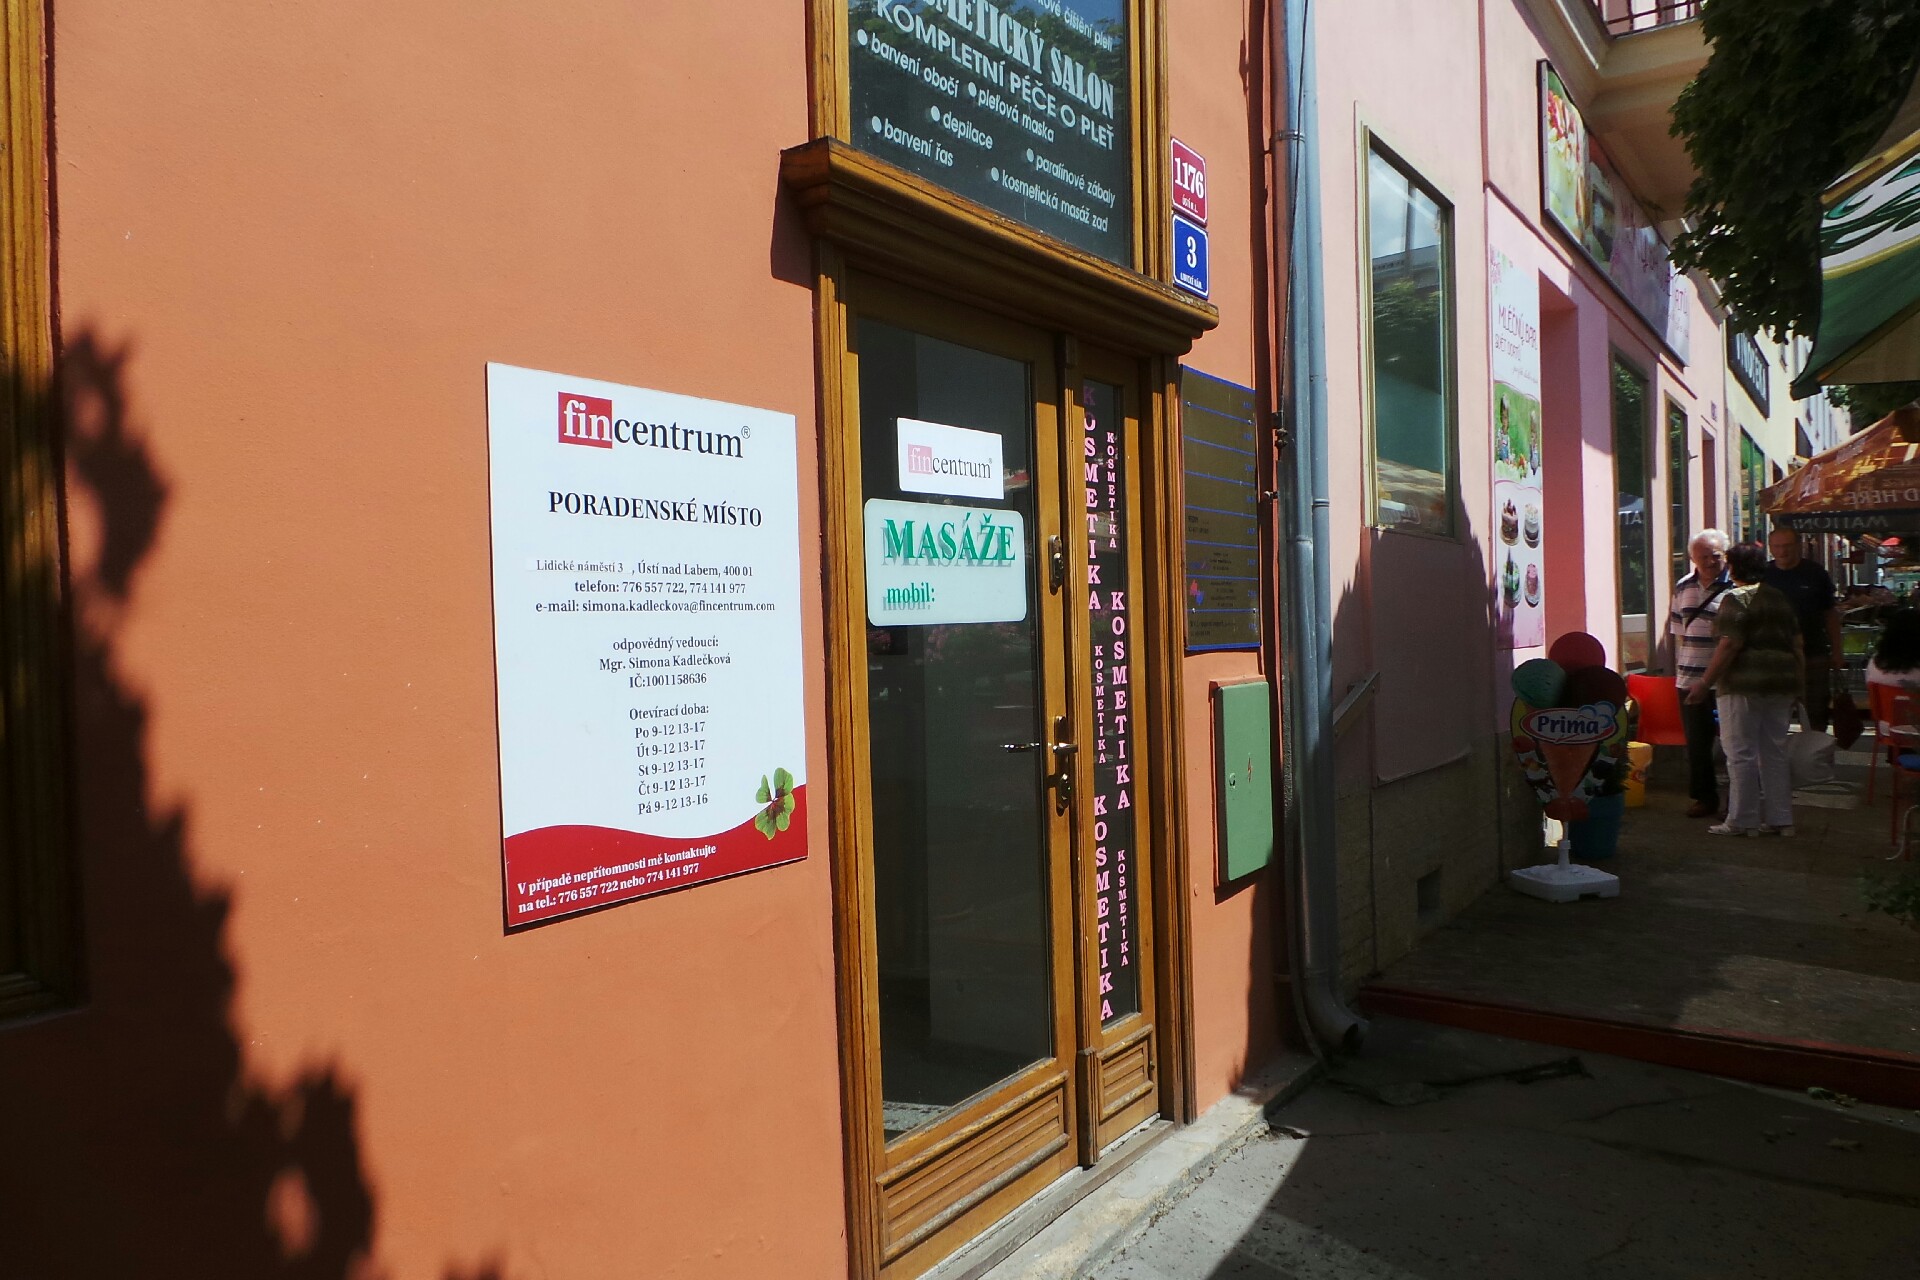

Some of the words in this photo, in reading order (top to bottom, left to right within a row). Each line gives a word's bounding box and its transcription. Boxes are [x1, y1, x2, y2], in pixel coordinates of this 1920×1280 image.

[871, 33, 921, 76] barvení
[923, 65, 960, 98] obočí
[877, 0, 1006, 87] KOMPLETNÍ
[1010, 74, 1056, 118] PÉČE
[1060, 104, 1076, 128] O
[1081, 114, 1114, 151] PLEŤ
[1050, 46, 1114, 119] SALON
[943, 111, 993, 150] depilace
[978, 86, 1019, 121] pleťová
[1022, 111, 1055, 143] maska
[884, 119, 932, 158] barvení
[935, 142, 954, 167] řas
[1087, 179, 1116, 209] zábaly
[1174, 157, 1205, 199] 1176
[1001, 170, 1058, 210] kosmetická
[1061, 198, 1090, 225] masáž
[1092, 213, 1108, 233] zad
[1186, 236, 1197, 268] 3
[548, 490, 698, 523] PORADENSKÉ
[702, 500, 762, 527] MÍSTO
[1083, 386, 1101, 611] KOSMETIKA
[1106, 431, 1117, 549] KOSMETIKA
[883, 512, 1016, 563] MASÁŽE
[536, 559, 575, 572] Lidické
[577, 560, 616, 573] náměstí
[617, 563, 624, 573] 3
[638, 560, 660, 575] Ústí
[662, 563, 681, 575] nad
[684, 564, 721, 577] Labem,
[723, 565, 741, 577] 400
[742, 566, 754, 577] 01
[575, 580, 619, 594] telefon:
[622, 581, 643, 593] 776
[644, 582, 665, 593] 557
[666, 582, 688, 595] 722,
[689, 583, 708, 594] 774
[710, 583, 726, 594] 141
[729, 583, 746, 594] 977
[535, 600, 580, 612] e-mail:
[582, 600, 776, 614] simona.kadleckova@fincentrum.com
[886, 582, 935, 604] mobil:
[599, 658, 626, 673] Mgr.
[628, 656, 670, 670] Simona
[672, 652, 731, 667] Kadlečková
[613, 637, 674, 653] odpovědný
[676, 635, 719, 649] vedoucí:
[629, 704, 679, 721] Otevírací
[680, 703, 709, 716] doba:
[1094, 645, 1107, 764] KOSMETIKA
[1111, 591, 1131, 810] KOSMETIKA
[635, 727, 649, 739] Po
[652, 723, 675, 737] 9-12
[677, 721, 706, 734] 13-17
[1537, 715, 1599, 735] Prima
[637, 743, 649, 758] Út
[652, 742, 675, 756] 9-12
[677, 739, 706, 753] 13-17
[638, 764, 649, 777] St
[651, 761, 675, 775] 9-12
[677, 758, 705, 771] 13-17
[638, 781, 651, 796] Čt
[652, 779, 676, 794] 9-12
[679, 775, 707, 789] 13-17
[638, 802, 652, 816] Pá
[654, 797, 677, 812] 9-12
[680, 793, 708, 808] 13-16
[517, 882, 526, 895] V
[528, 873, 572, 895] případě
[573, 857, 646, 884] nepřítomnosti
[647, 854, 663, 868] mě
[664, 844, 717, 862] kontaktujte
[518, 901, 534, 914] na
[535, 893, 557, 909] tel.:
[558, 888, 578, 904] 776
[579, 884, 598, 899] 557
[599, 880, 619, 895] 722
[620, 875, 645, 890] nebo
[646, 869, 664, 884] 774
[665, 866, 681, 880] 141
[682, 862, 700, 876] 977
[1094, 794, 1114, 1021] KOSMETIKA
[1117, 849, 1129, 967] KOSMETIKA
